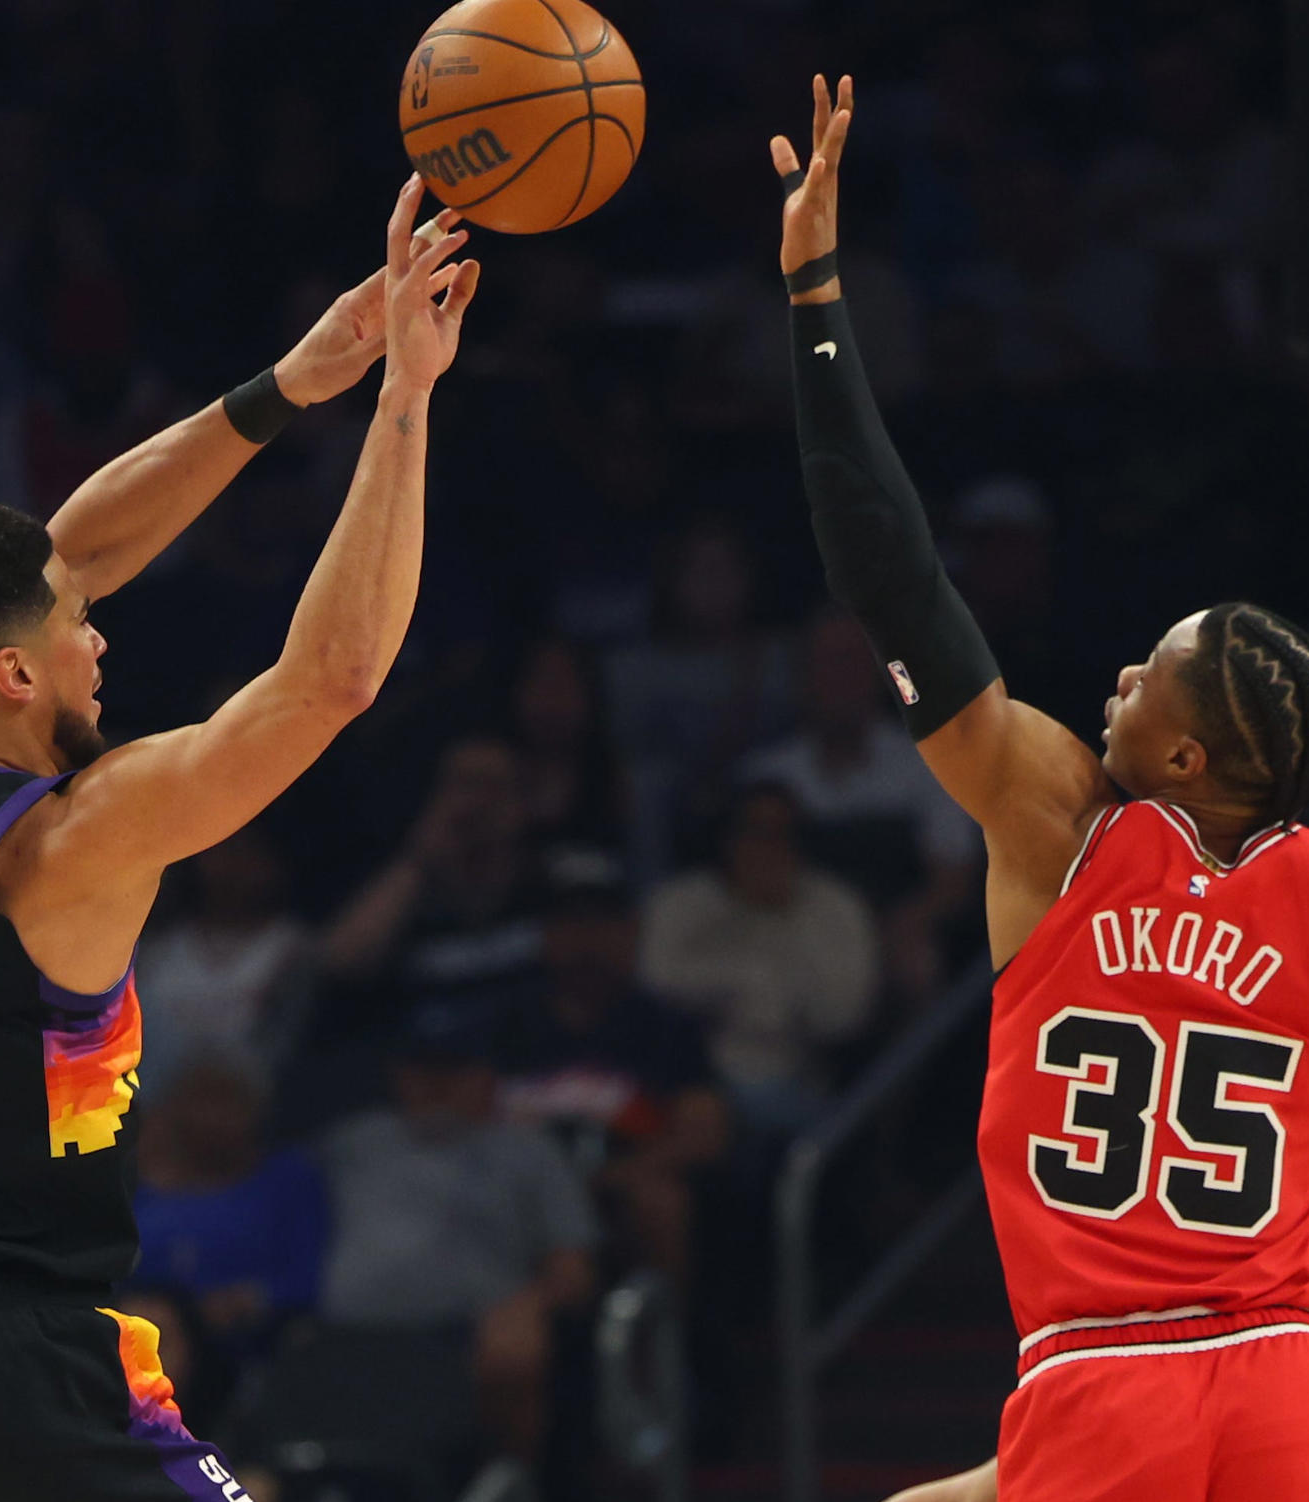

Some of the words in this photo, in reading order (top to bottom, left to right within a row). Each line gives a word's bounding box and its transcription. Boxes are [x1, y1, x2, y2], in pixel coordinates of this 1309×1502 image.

[408, 127, 514, 188] Wil
[1092, 906, 1283, 1006] OKORO
[1028, 1006, 1304, 1238] 35
